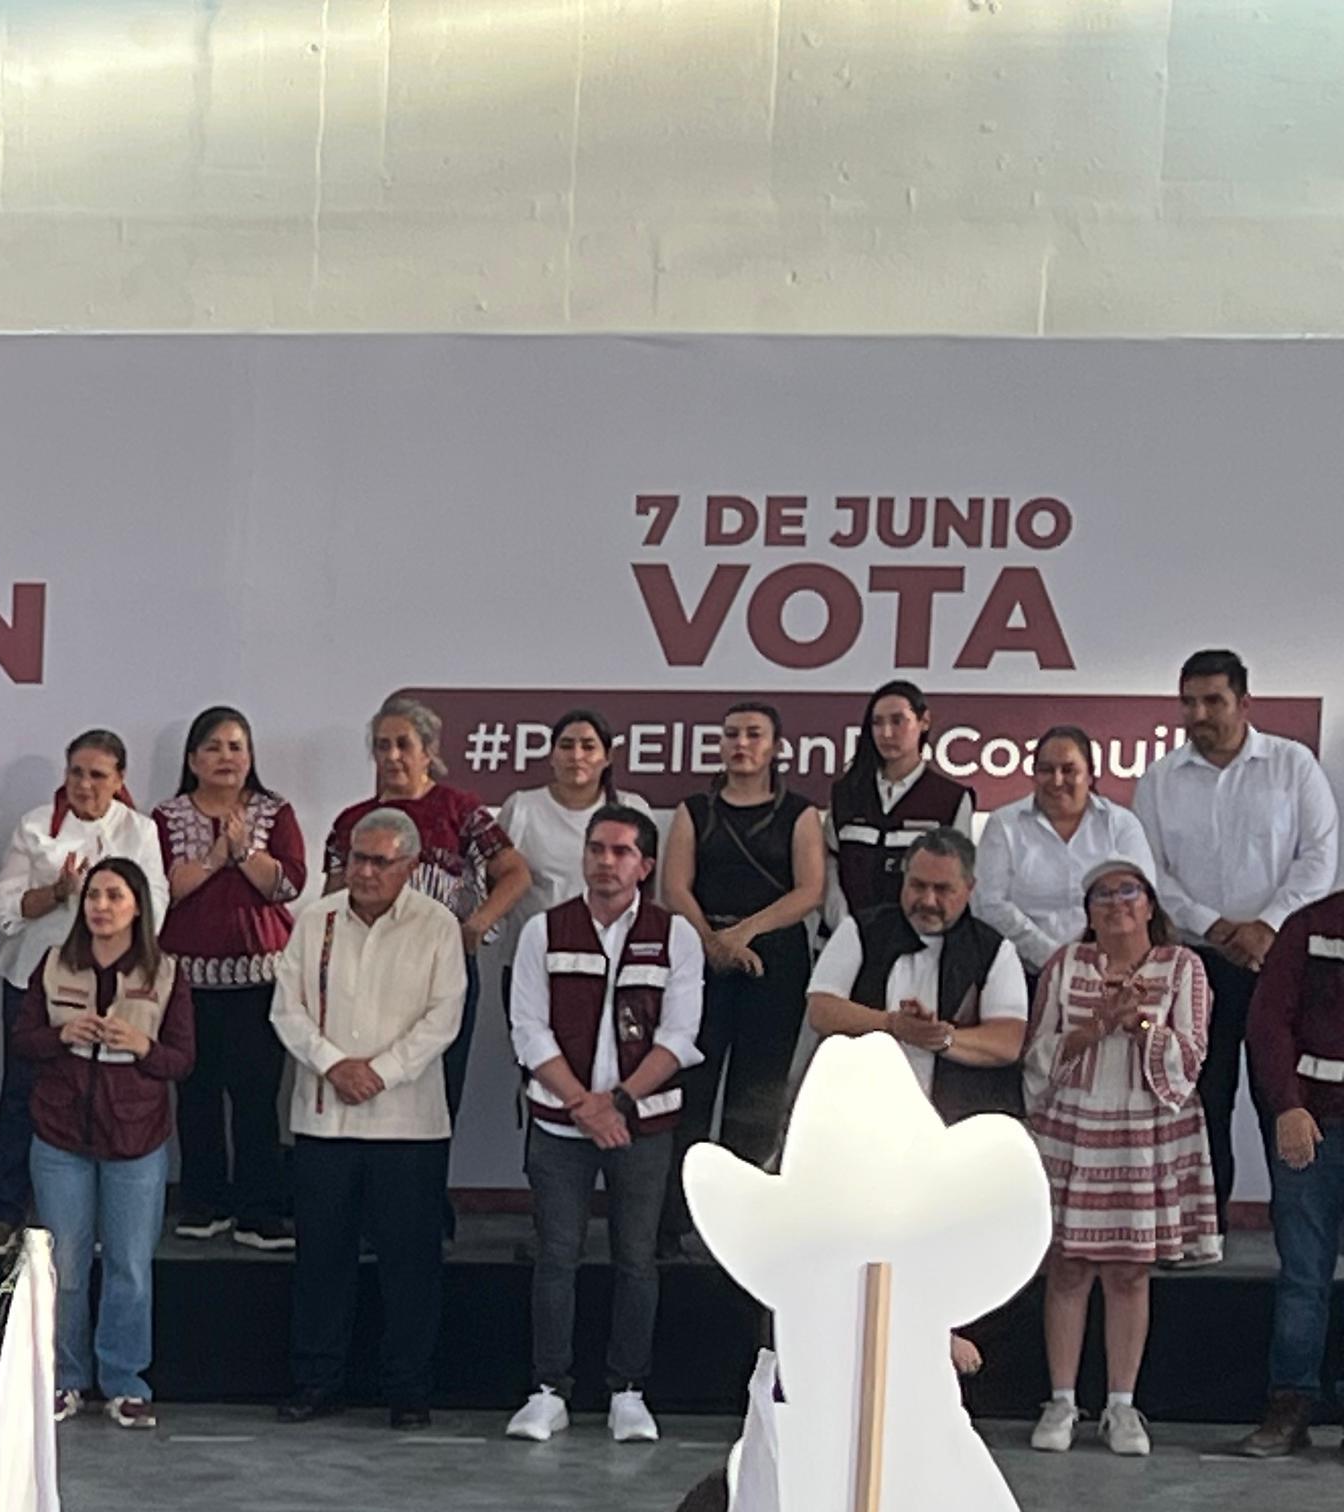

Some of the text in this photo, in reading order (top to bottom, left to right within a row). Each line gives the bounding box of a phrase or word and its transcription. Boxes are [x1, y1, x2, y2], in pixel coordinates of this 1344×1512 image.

[635, 494, 1073, 550] 7 DE JUNIO
[631, 562, 1076, 670] VOTA
